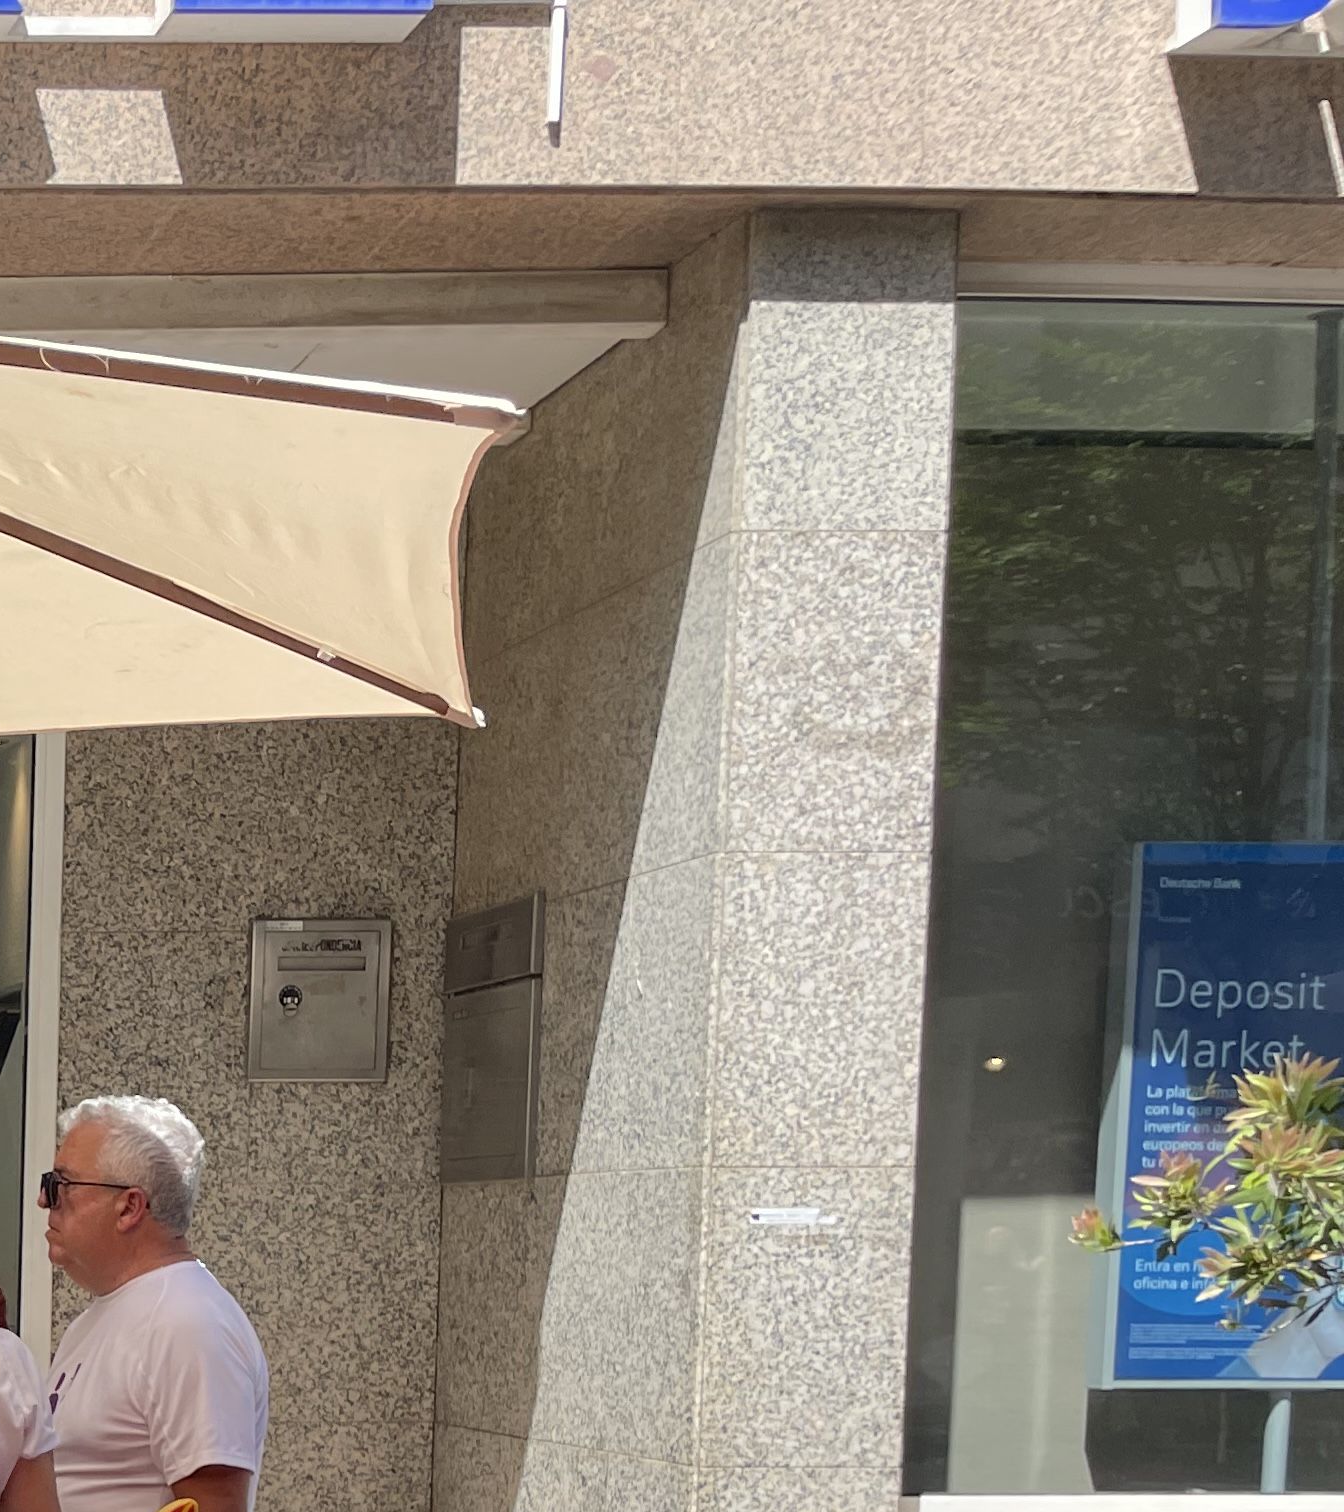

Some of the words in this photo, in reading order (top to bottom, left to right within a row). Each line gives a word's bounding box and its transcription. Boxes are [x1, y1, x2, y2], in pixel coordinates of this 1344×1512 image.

[1160, 877, 1212, 888] Deutsche
[1213, 878, 1241, 889] Bank
[1154, 969, 1327, 1019] Deposit
[1149, 1028, 1306, 1068] Market
[1146, 1084, 1163, 1098] La
[1145, 1106, 1169, 1116] con
[1172, 1103, 1185, 1116] la
[1187, 1105, 1212, 1118] que
[1144, 1120, 1191, 1133] invertir
[1193, 1124, 1210, 1133] en
[1142, 1140, 1205, 1154] europeos
[1141, 1156, 1157, 1168] tu
[1134, 1259, 1171, 1273] Entra
[1173, 1262, 1190, 1273] en
[1133, 1276, 1177, 1290] oficina
[1180, 1279, 1189, 1290] e
